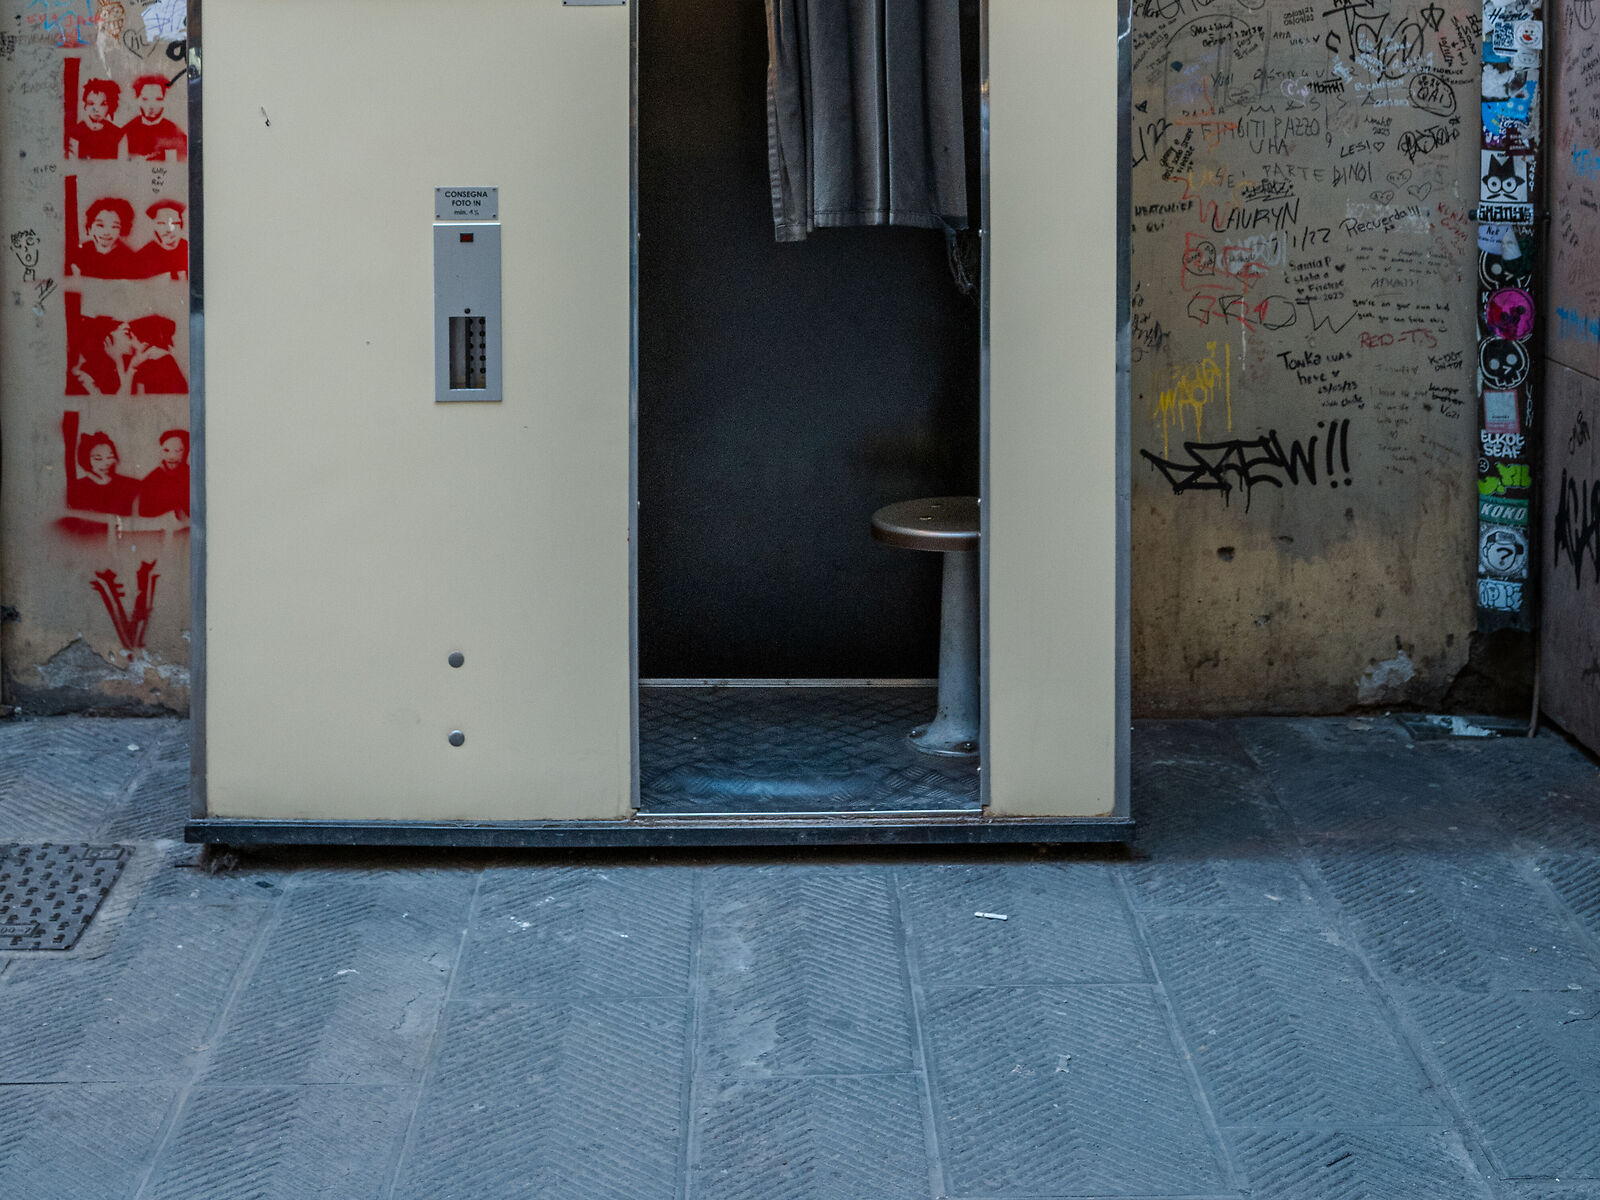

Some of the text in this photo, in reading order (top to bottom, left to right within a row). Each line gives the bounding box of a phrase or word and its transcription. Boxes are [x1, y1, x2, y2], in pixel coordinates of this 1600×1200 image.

[444, 190, 489, 199] CONSEGNA
[451, 199, 471, 207] FOTO
[1212, 197, 1300, 234] LAURYN
[1480, 502, 1528, 521] KOKO
